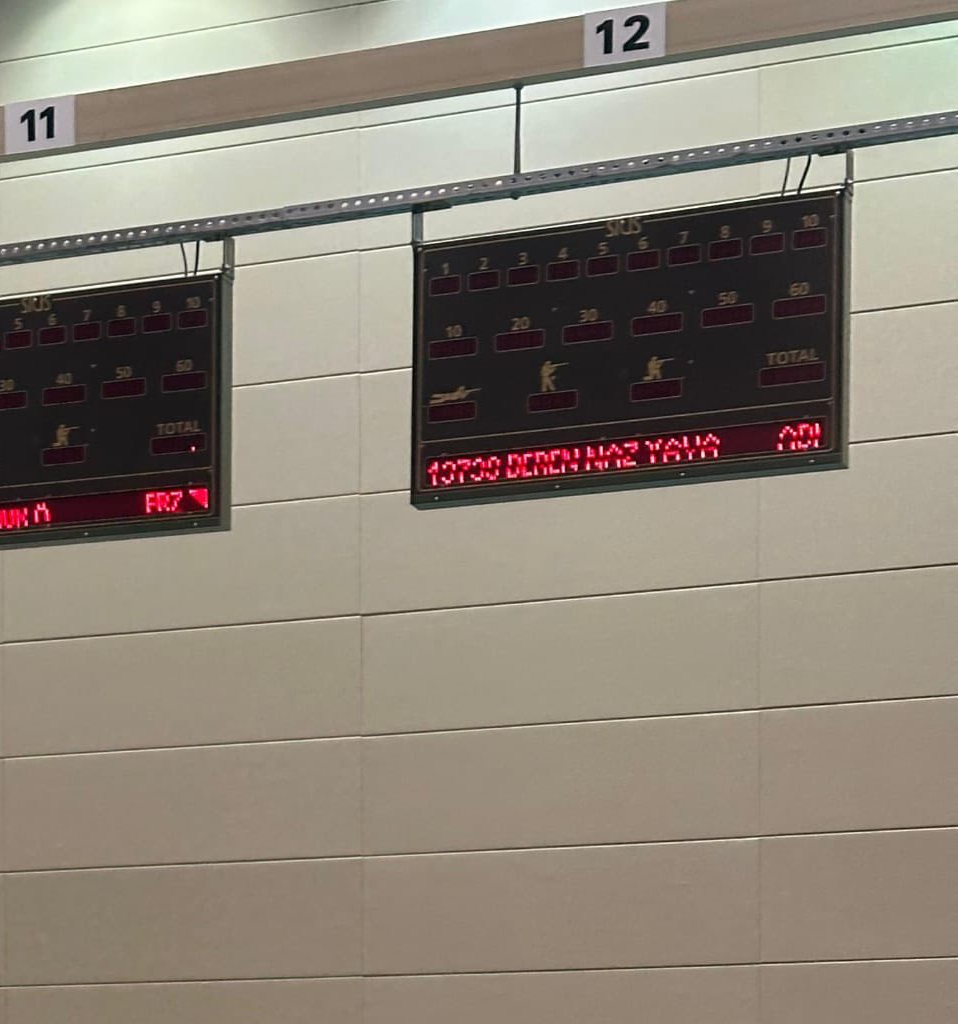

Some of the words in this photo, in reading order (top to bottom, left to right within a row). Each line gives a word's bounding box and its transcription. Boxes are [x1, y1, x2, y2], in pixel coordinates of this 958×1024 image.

[595, 14, 650, 54] 12
[20, 105, 55, 141] 11
[442, 263, 450, 275] 1
[479, 257, 489, 270] 2
[518, 252, 528, 265] 3
[557, 247, 568, 259] 4
[599, 242, 610, 255] 5
[638, 237, 649, 249] 6
[679, 231, 690, 244] 7
[720, 225, 731, 238] 8
[762, 220, 773, 232] 9
[802, 214, 820, 227] 10
[445, 325, 463, 338] 10
[511, 316, 530, 330] 20
[579, 309, 599, 322] 30
[647, 300, 667, 313] 40
[718, 291, 739, 305] 50
[789, 282, 810, 296] 60
[55, 373, 73, 385] 40
[116, 366, 132, 378] 50
[176, 359, 193, 372] 60
[765, 348, 819, 365] TOTAL
[156, 420, 201, 435] TOTAL
